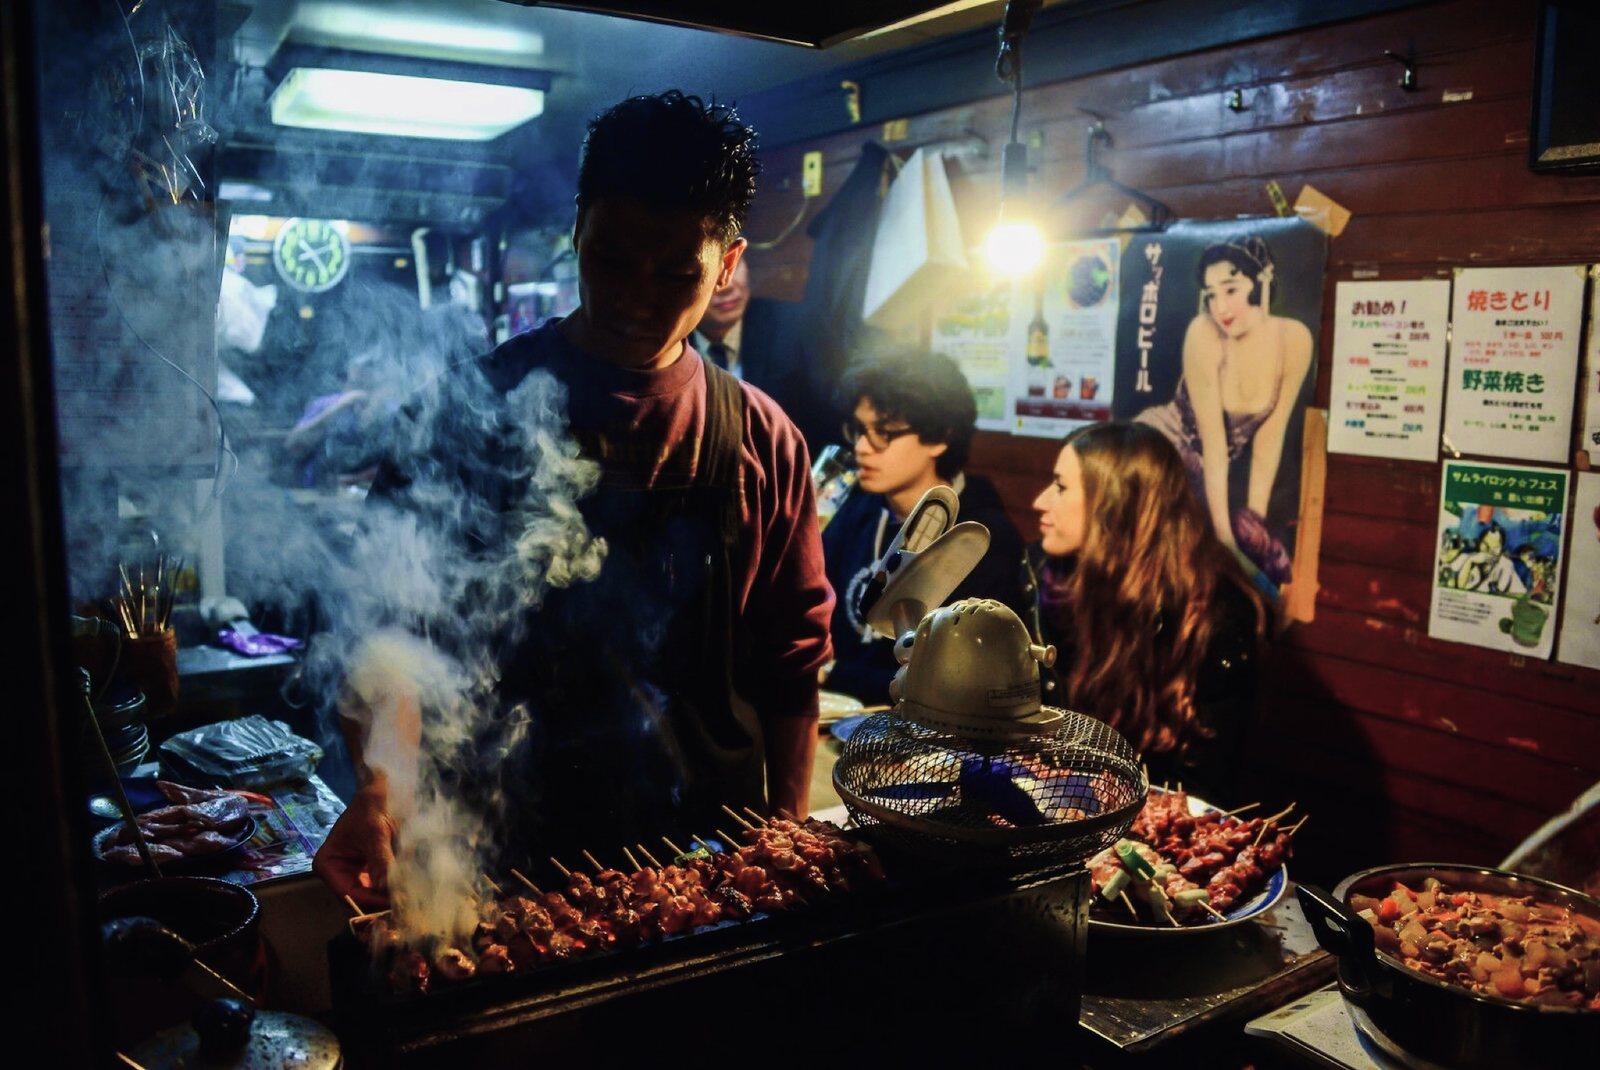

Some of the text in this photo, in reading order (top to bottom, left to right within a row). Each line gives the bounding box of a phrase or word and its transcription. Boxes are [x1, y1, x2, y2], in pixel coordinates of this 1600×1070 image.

[1467, 290, 1550, 311] 焼きとり
[1135, 243, 1164, 392] サッポロビール
[1463, 370, 1544, 393] 野菜焼き
